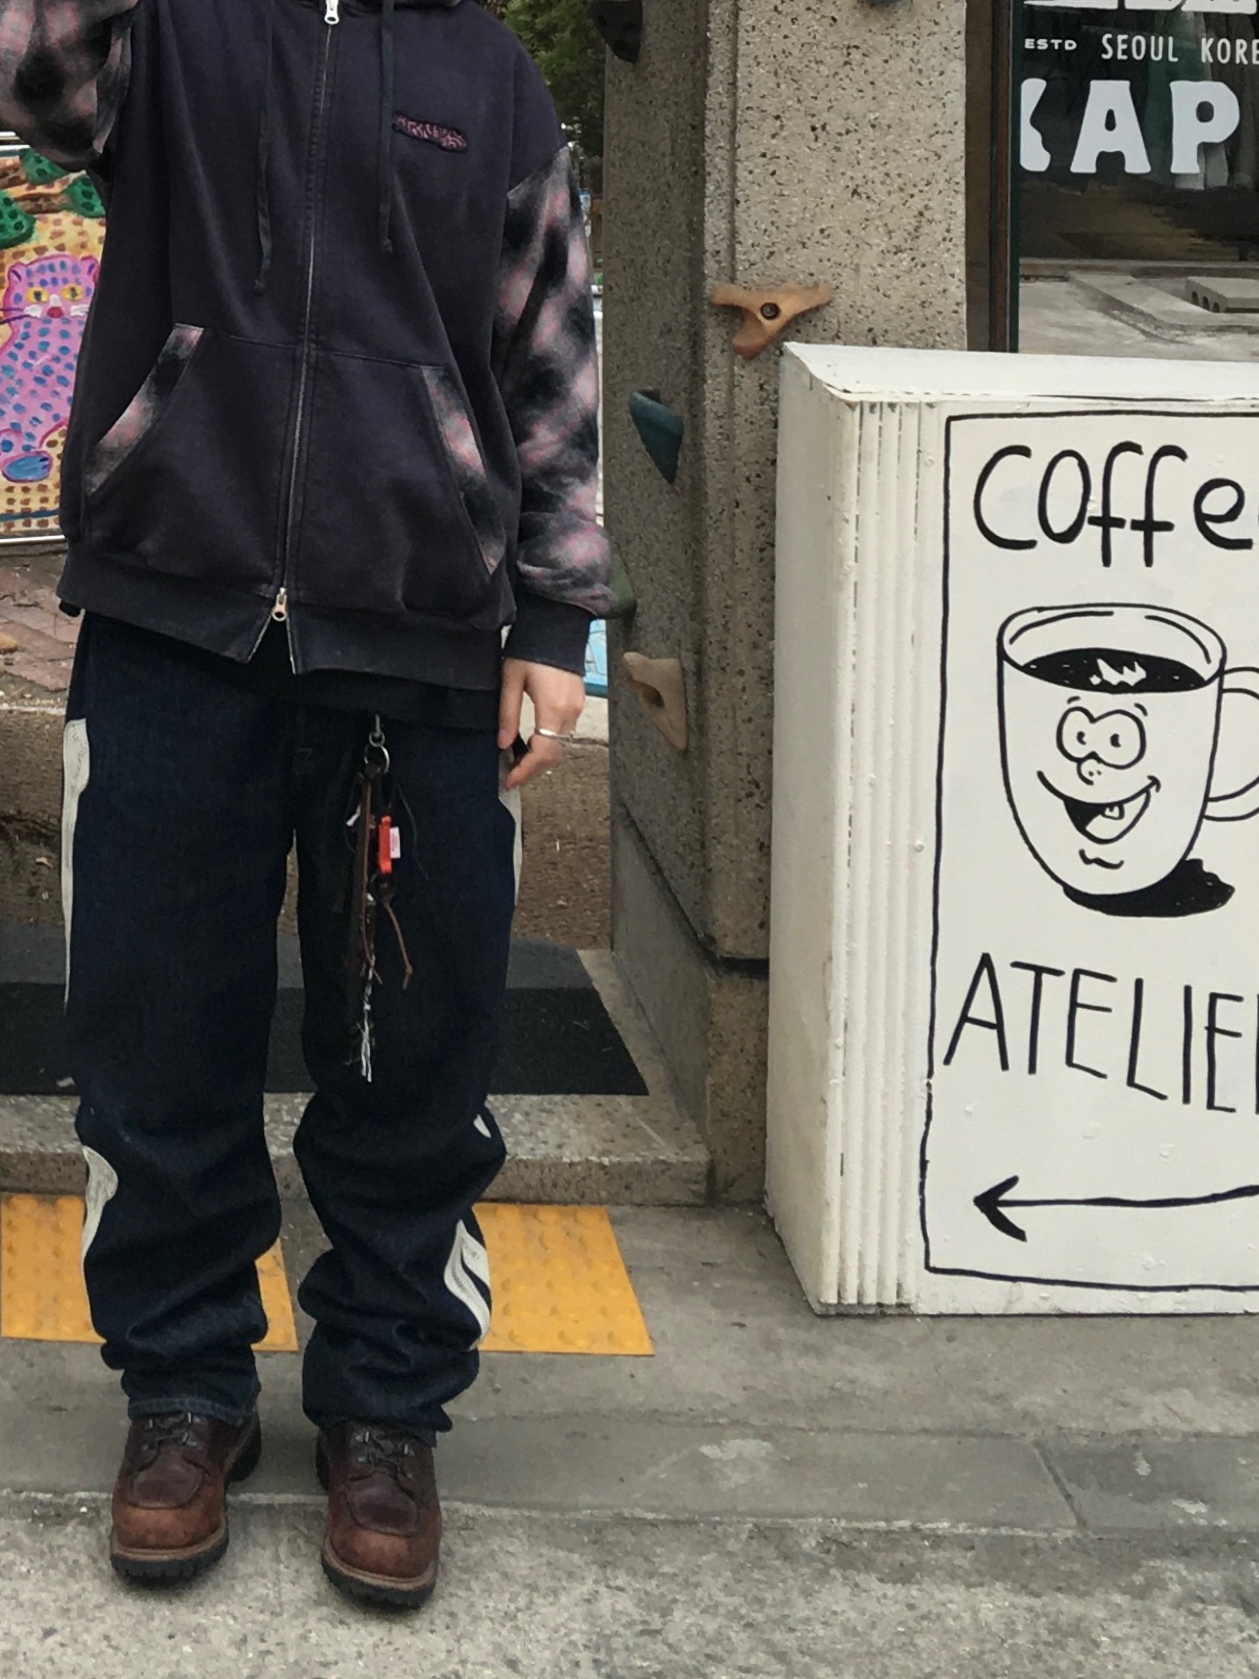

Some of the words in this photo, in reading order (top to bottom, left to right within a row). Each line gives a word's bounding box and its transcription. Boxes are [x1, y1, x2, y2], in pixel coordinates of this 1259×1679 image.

[1024, 38, 1078, 51] ESTD
[1101, 33, 1179, 62] SEOUL
[973, 440, 1259, 568] Coffe
[942, 952, 1259, 1115] ATELIE
